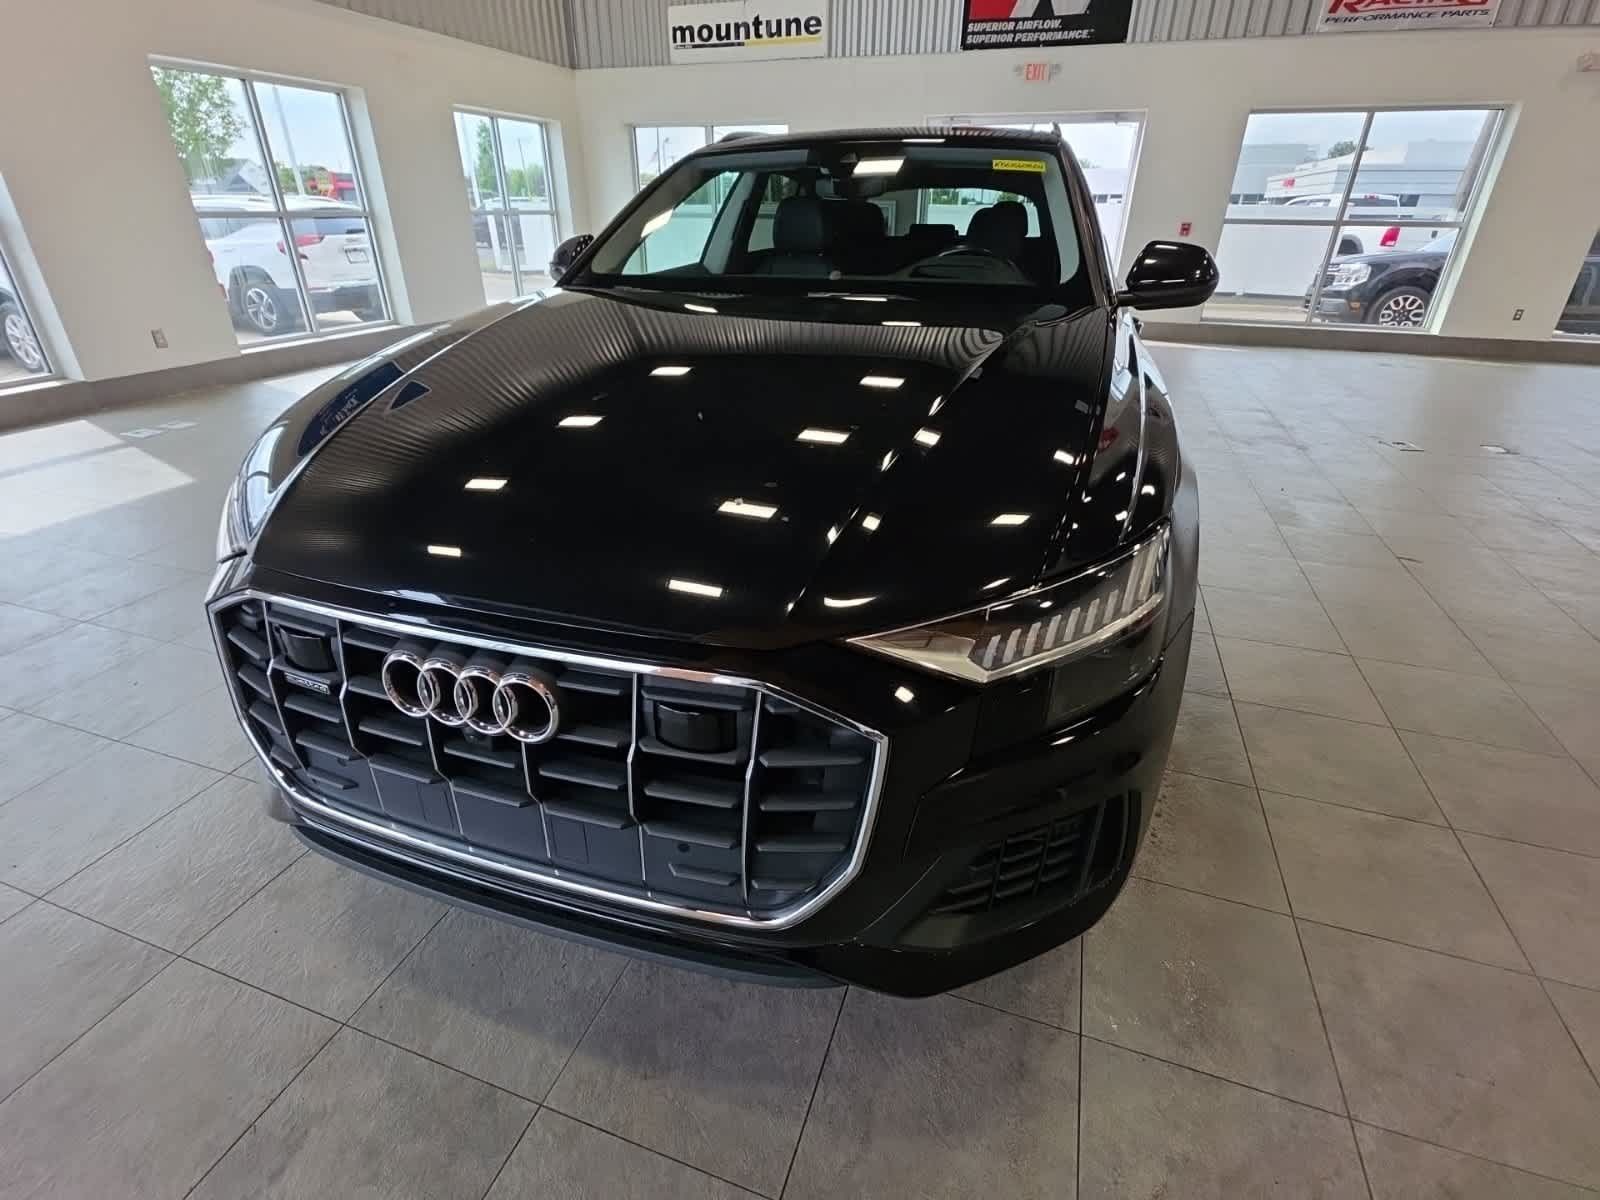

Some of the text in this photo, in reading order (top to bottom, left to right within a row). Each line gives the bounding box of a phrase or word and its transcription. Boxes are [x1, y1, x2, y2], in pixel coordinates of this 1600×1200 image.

[1325, 9, 1490, 24] PERFORMANCE PARTS
[671, 14, 823, 43] mountune
[967, 19, 1063, 32] SUPERIOR AIRFLOW.
[966, 32, 1013, 44] SUPERIOR
[1025, 63, 1048, 81] EXIT
